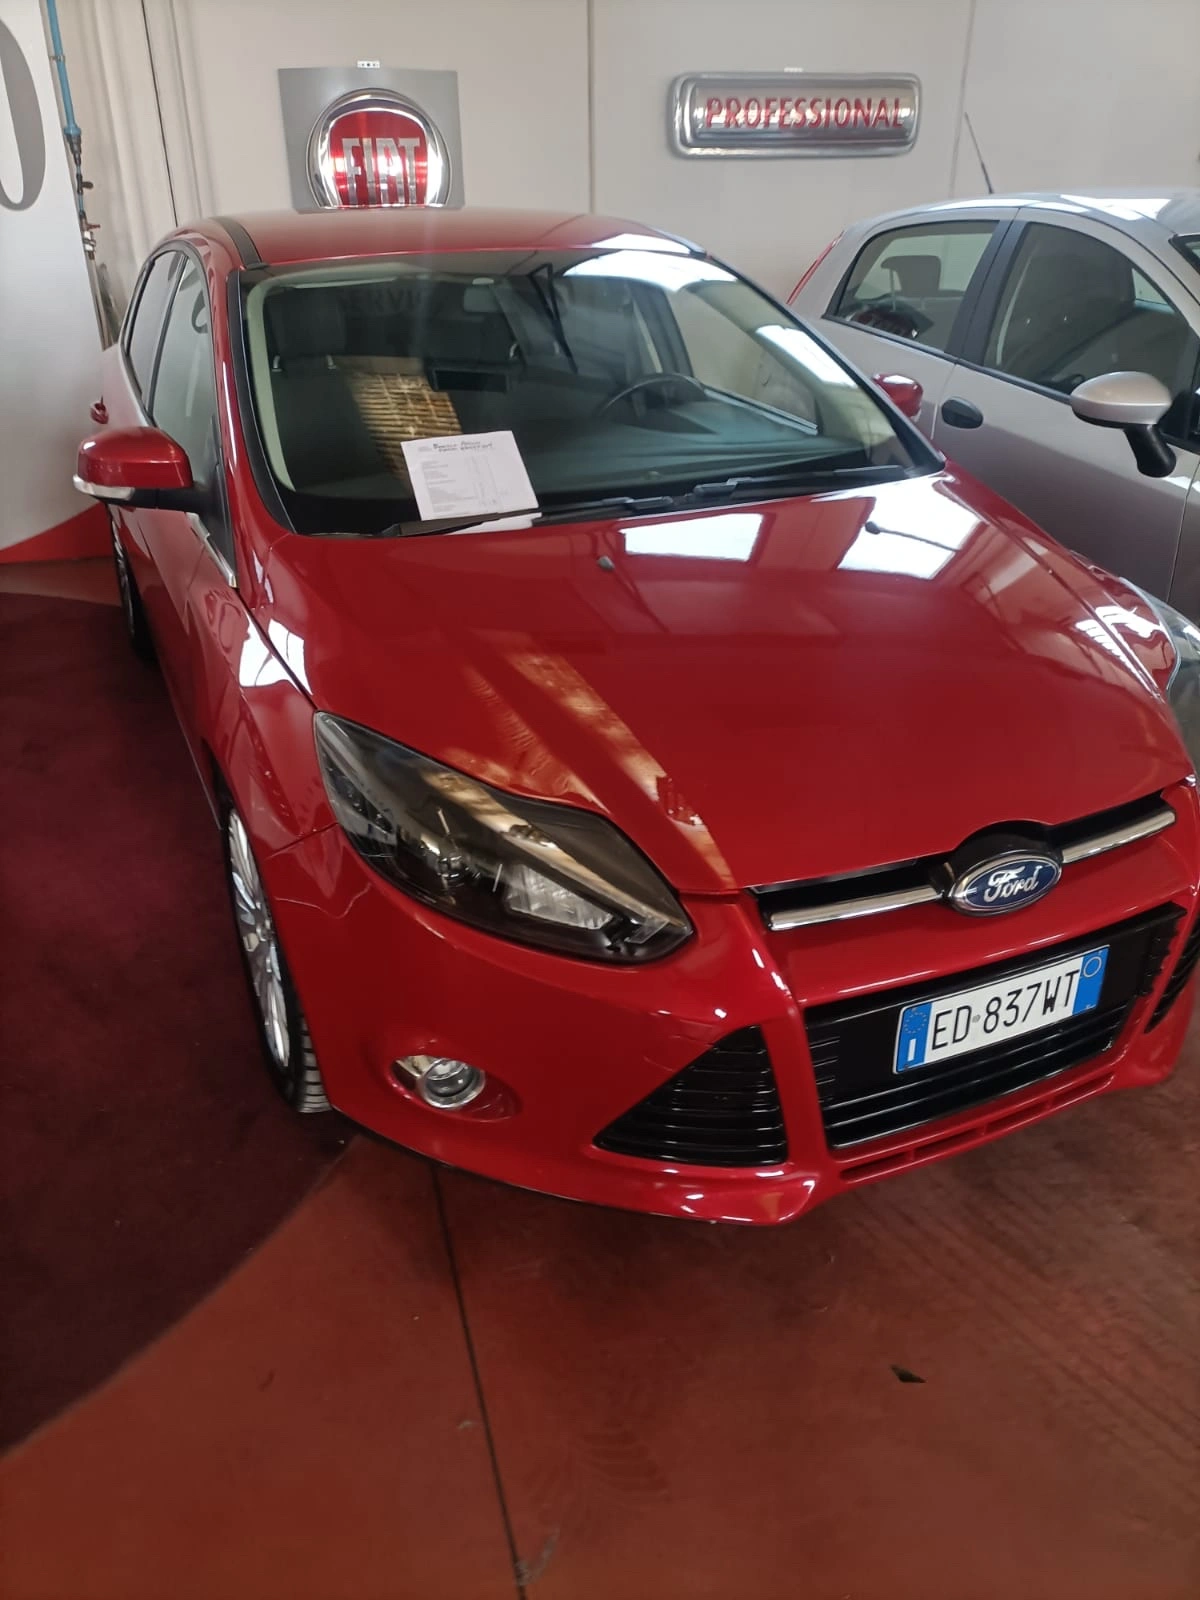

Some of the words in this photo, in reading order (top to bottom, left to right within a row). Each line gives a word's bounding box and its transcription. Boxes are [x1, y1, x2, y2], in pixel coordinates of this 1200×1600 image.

[705, 97, 904, 129] PROFESSIONAL
[341, 137, 421, 206] FIAT
[983, 865, 1043, 903] Ford
